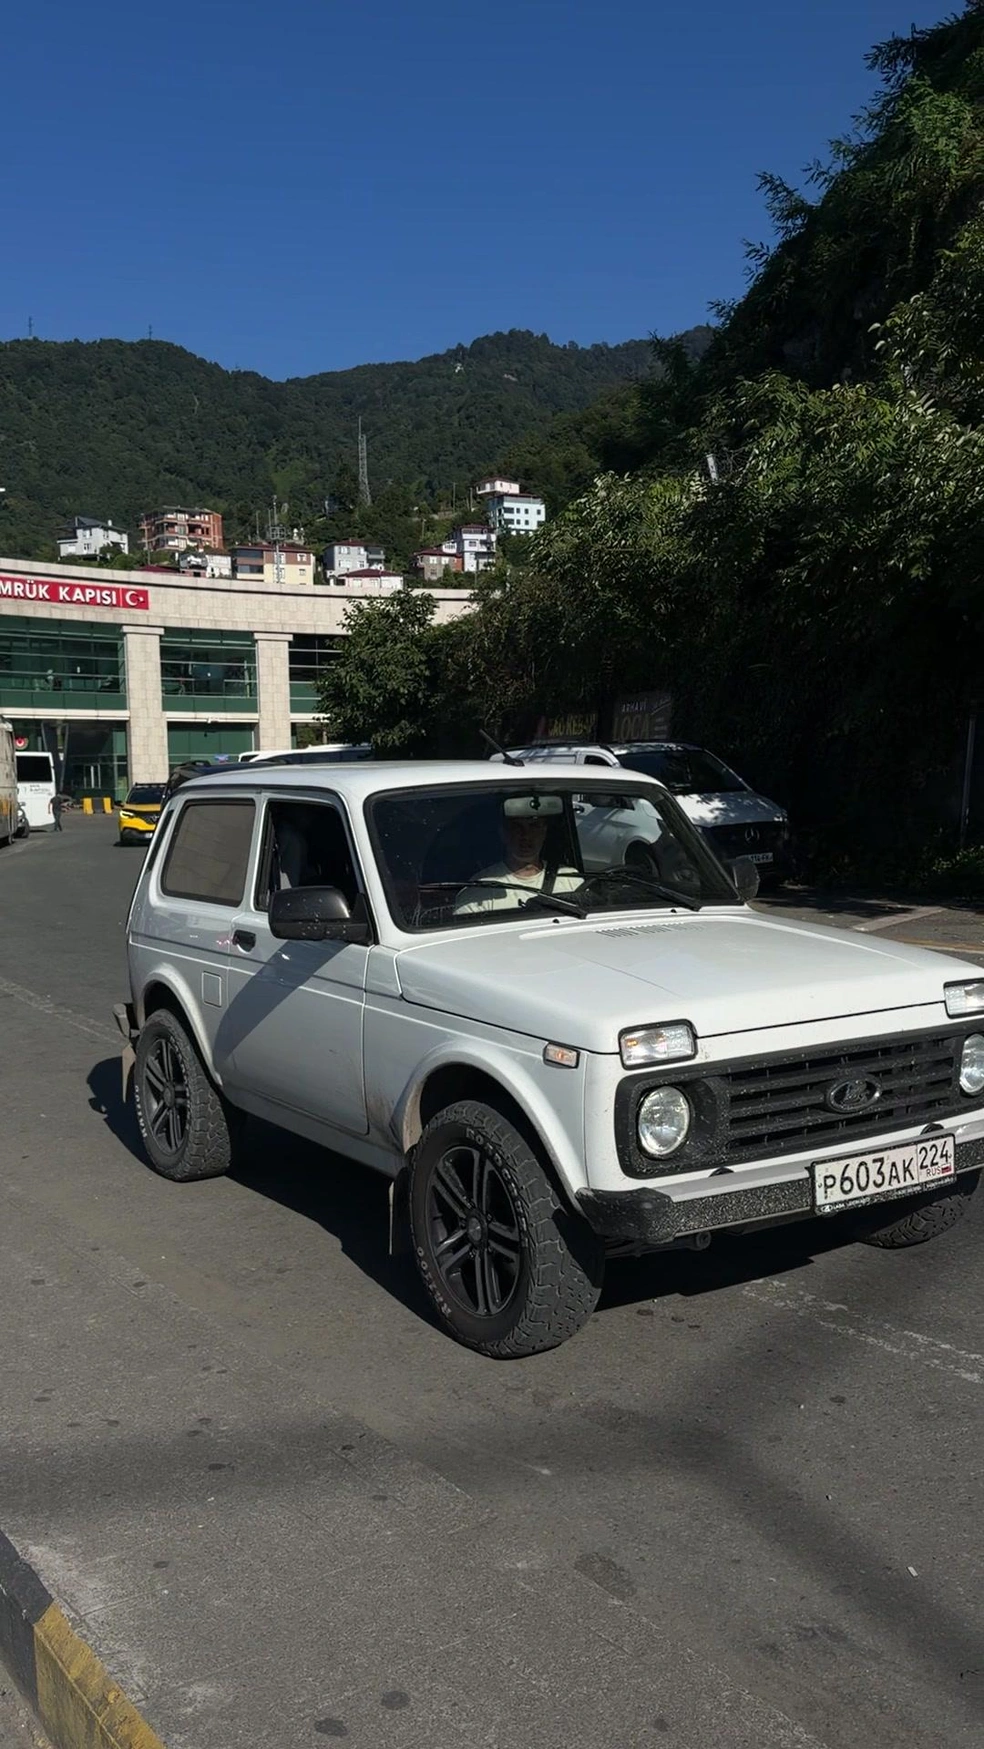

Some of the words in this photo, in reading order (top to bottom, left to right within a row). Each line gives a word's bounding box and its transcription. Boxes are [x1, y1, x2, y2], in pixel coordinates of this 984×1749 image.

[0, 580, 50, 599] MRÜK
[59, 586, 117, 605] KAPISI
[918, 1140, 949, 1170] 224
[926, 1166, 941, 1177] RUS
